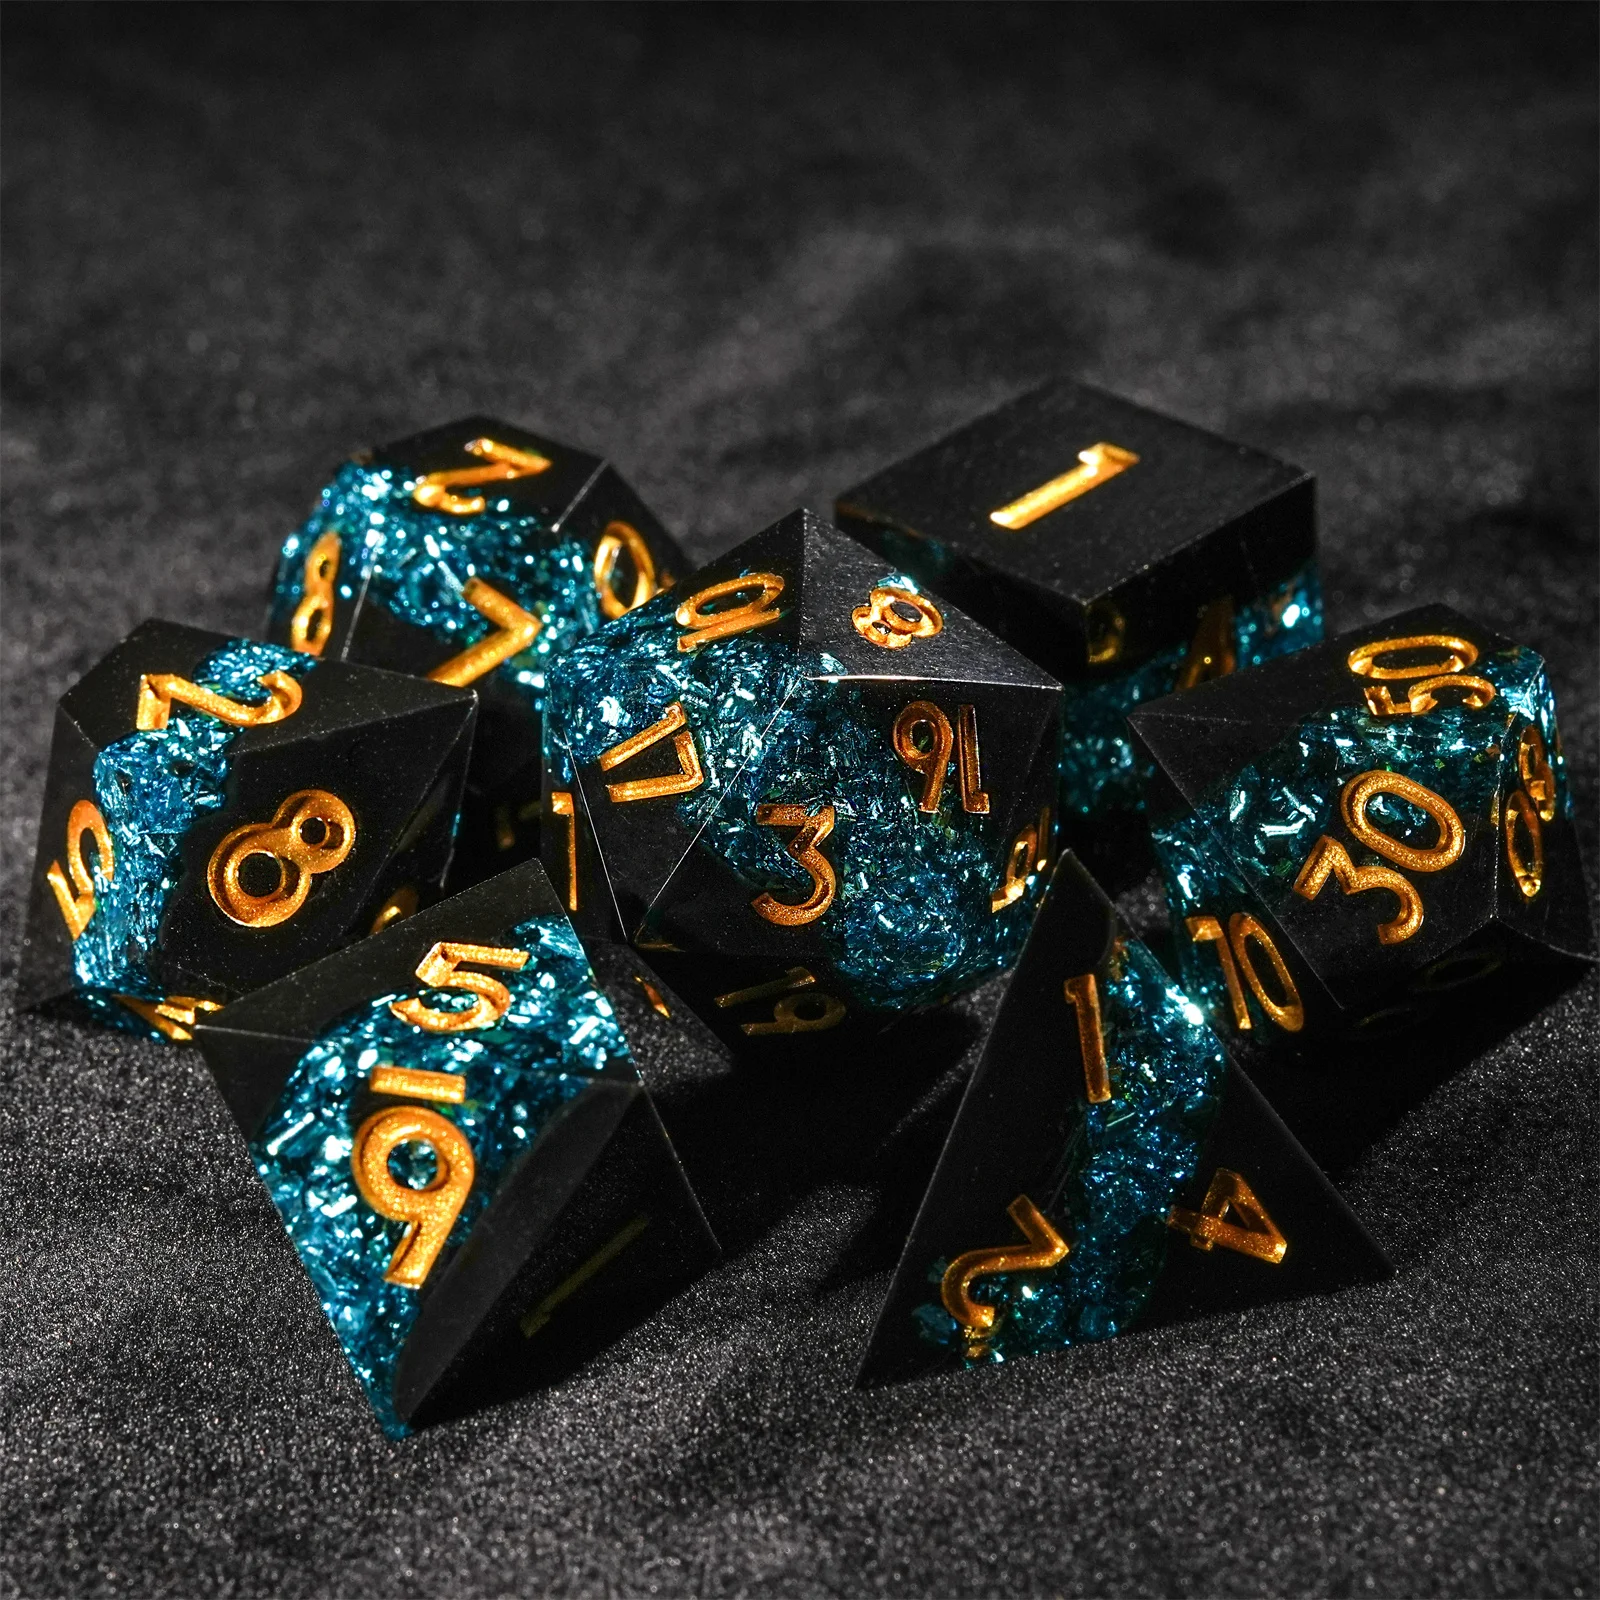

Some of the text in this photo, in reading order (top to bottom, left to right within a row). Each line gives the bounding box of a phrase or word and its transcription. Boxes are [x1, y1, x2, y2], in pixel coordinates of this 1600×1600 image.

[411, 437, 554, 516] 2
[989, 440, 1140, 531] 1
[290, 530, 343, 656] 8
[674, 571, 786, 653] 10
[851, 584, 944, 650] 8
[136, 669, 303, 731] 2
[1347, 632, 1496, 718] 50
[600, 701, 705, 803] 17
[206, 787, 357, 929] 8
[750, 803, 837, 927] 3
[1293, 769, 1466, 946] 30
[387, 940, 532, 1034] 5
[1184, 911, 1306, 1034] 10
[1063, 972, 1112, 1104] 1
[940, 1193, 1070, 1328] 2
[1166, 1167, 1289, 1265] 4
